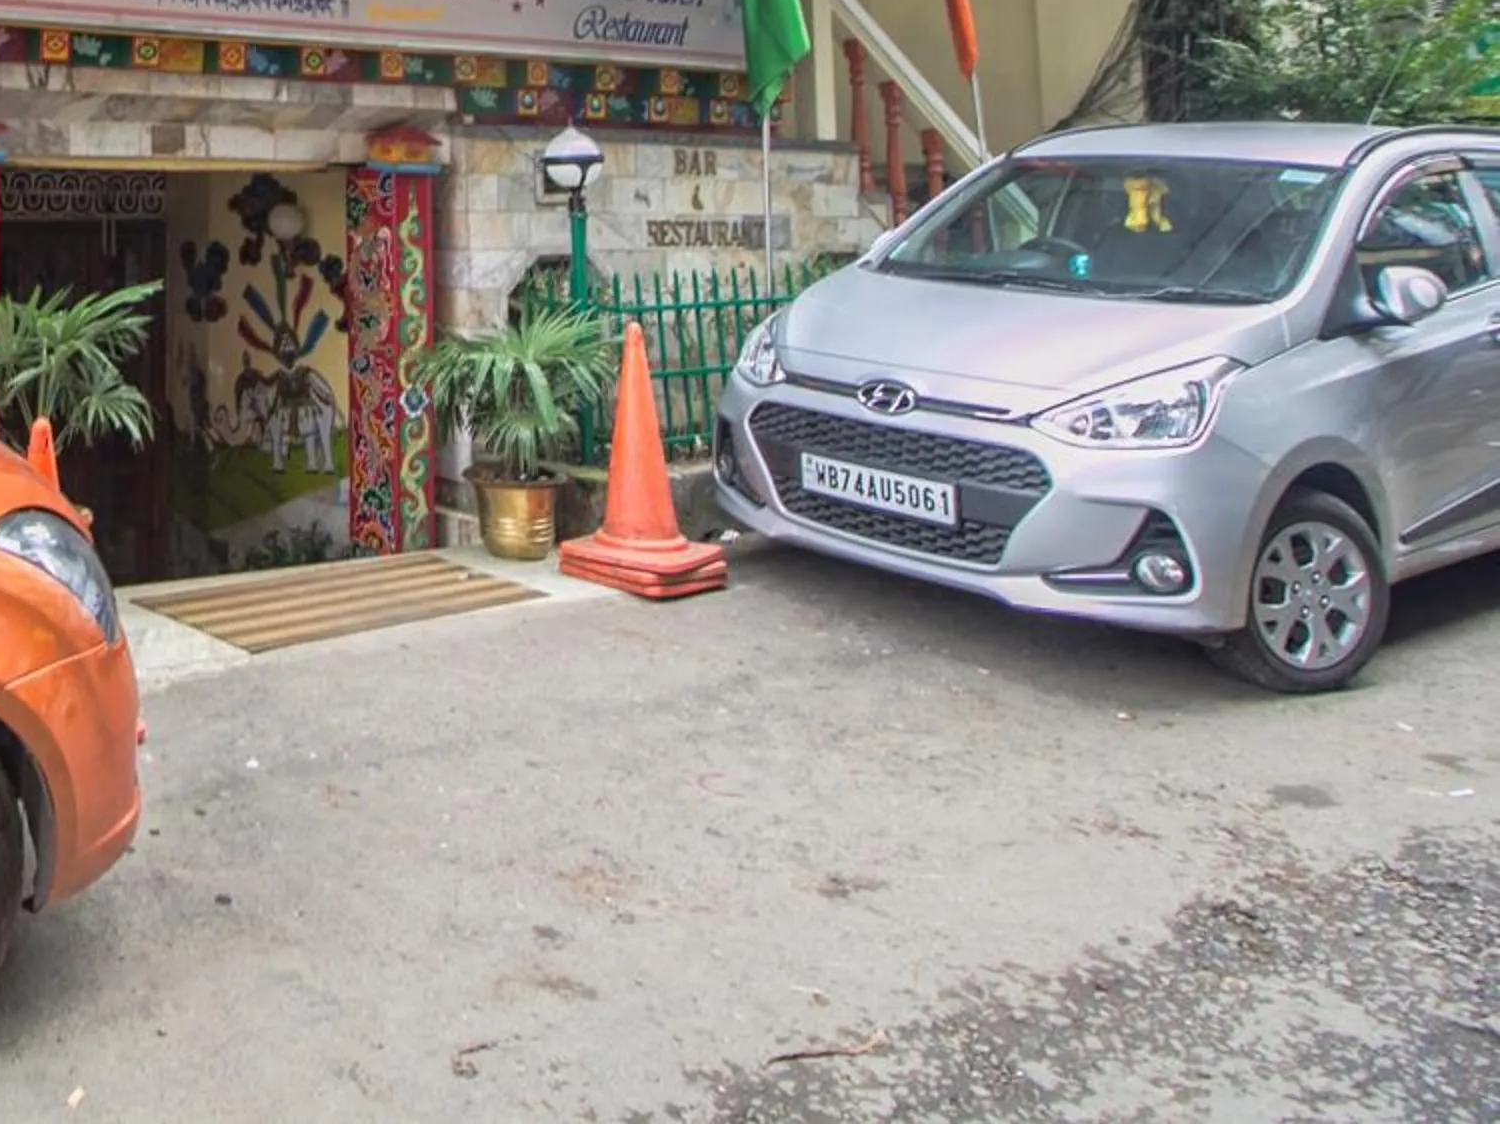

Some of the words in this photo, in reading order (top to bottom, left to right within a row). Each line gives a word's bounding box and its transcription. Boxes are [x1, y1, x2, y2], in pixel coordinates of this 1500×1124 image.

[573, 4, 689, 46] Restaurant
[673, 149, 718, 177] BAR
[646, 219, 766, 250] RESTAURANT
[815, 461, 950, 516] WB74AU5061
